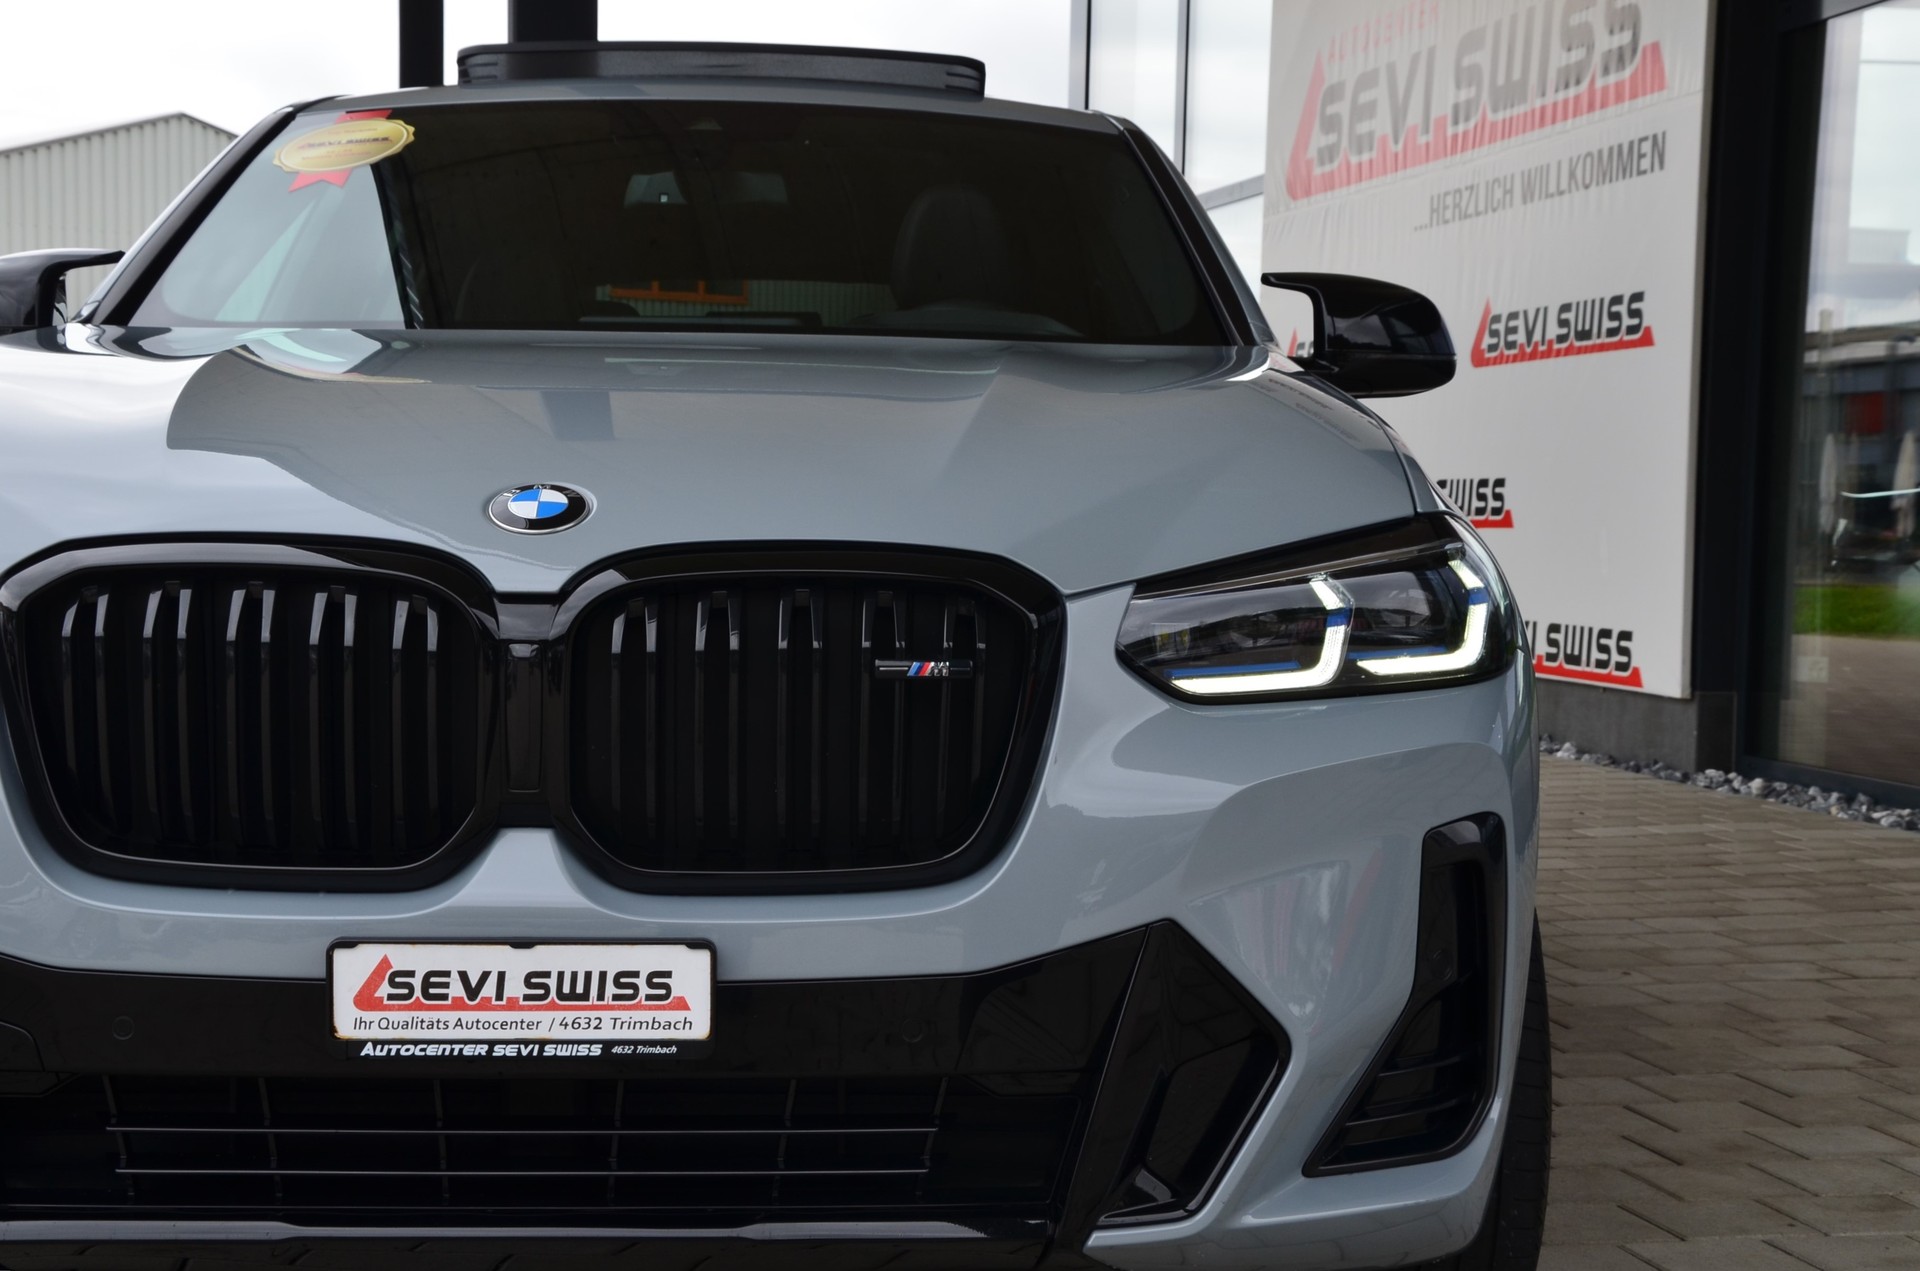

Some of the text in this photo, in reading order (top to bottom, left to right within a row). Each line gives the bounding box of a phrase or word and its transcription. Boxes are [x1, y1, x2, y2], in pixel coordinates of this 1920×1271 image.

[1316, 0, 1642, 169] SEVI SWISS
[1521, 130, 1667, 206] WILLKOMMEN
[1487, 290, 1645, 353] SEVI SWISS
[1545, 622, 1633, 673] SWISS
[386, 969, 673, 1002] SEVI SWISS
[353, 1017, 375, 1030] Ihr
[378, 1016, 449, 1031] Qualitäts
[453, 1017, 542, 1031] Autocenter
[610, 1016, 693, 1031] Trimbach
[492, 1043, 540, 1057] SEVI
[543, 1043, 603, 1057] SWISS
[611, 1045, 634, 1055] 4632
[636, 1045, 677, 1055] Trimbach
